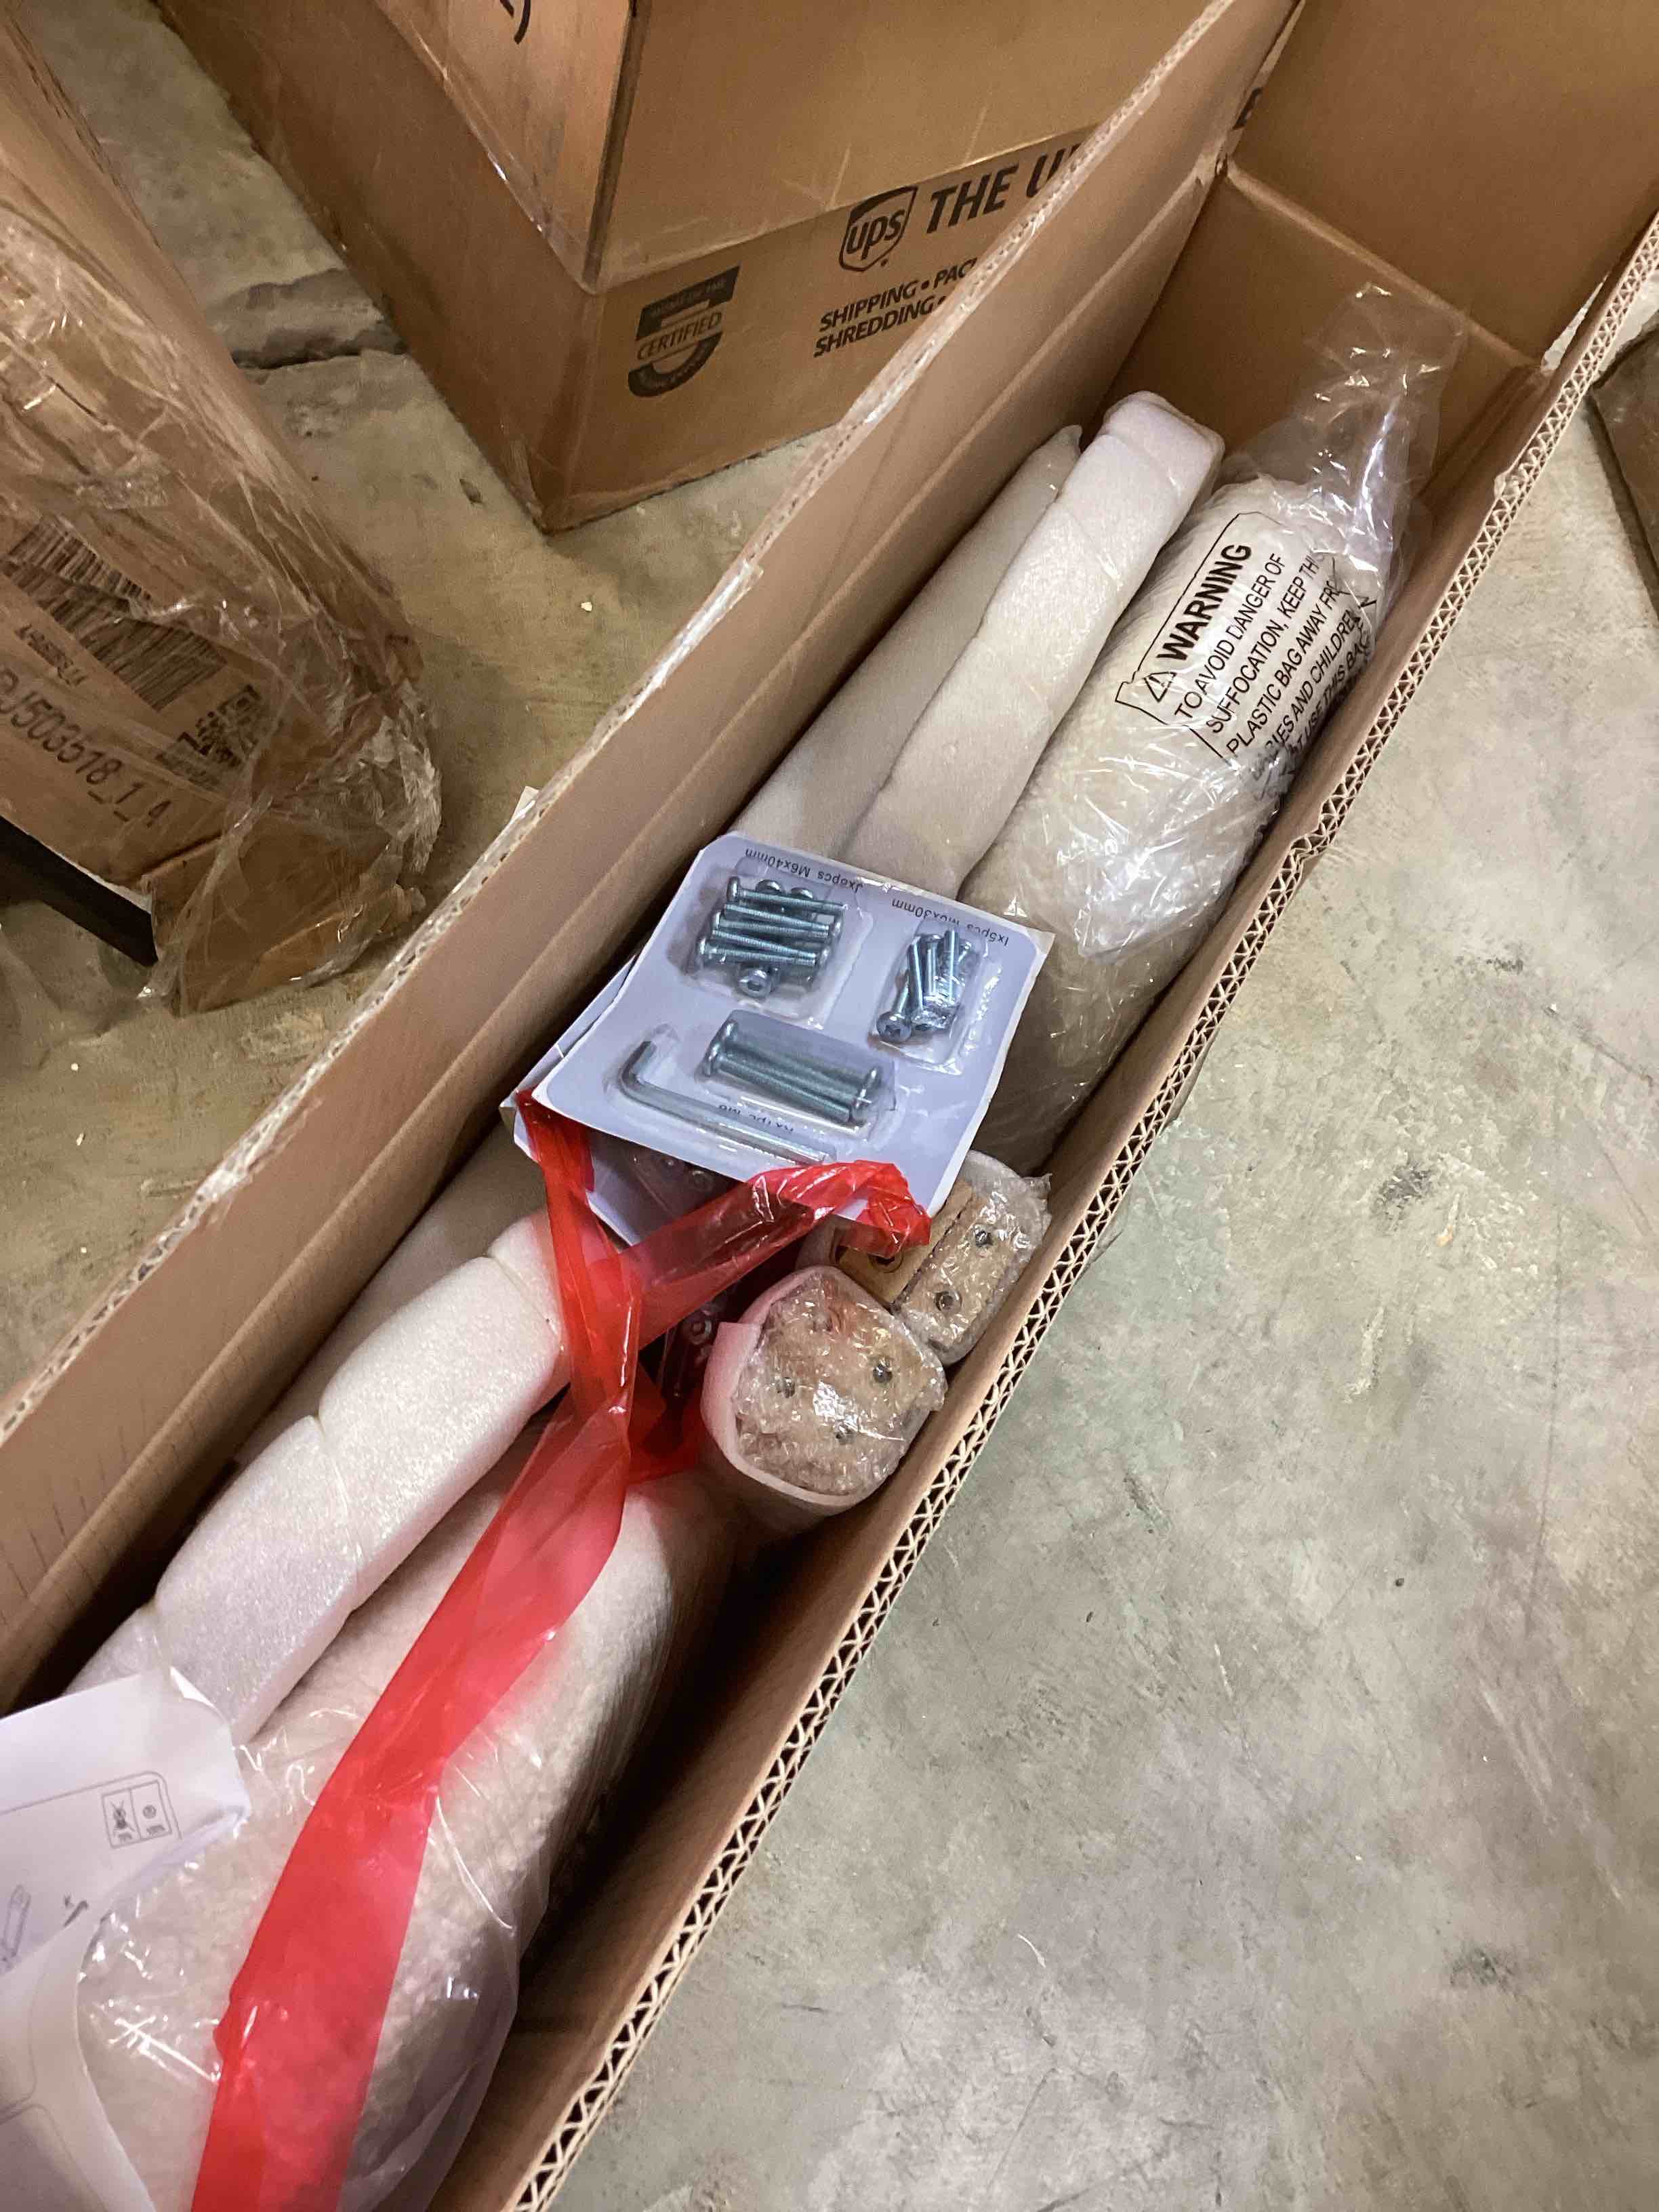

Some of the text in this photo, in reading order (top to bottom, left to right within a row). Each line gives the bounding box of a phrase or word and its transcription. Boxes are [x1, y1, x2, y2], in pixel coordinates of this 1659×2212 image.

[926, 142, 1082, 234] THE U
[846, 209, 905, 260] ups
[637, 312, 722, 361] CERTIFIED
[814, 295, 935, 358] SHREDDING
[819, 281, 918, 331] SHIPPING
[1156, 544, 1252, 660] WARNING
[1174, 552, 1286, 718] TO AVOID DANGER OF
[1206, 619, 1289, 733] SUFFOCATION,
[1277, 576, 1307, 619] KEEP
[1226, 684, 1282, 755] PLASTIC
[1275, 648, 1303, 687] BAG
[1296, 603, 1327, 655] AWAY
[1291, 680, 1313, 722] AND
[745, 848, 812, 878] M6x40mm
